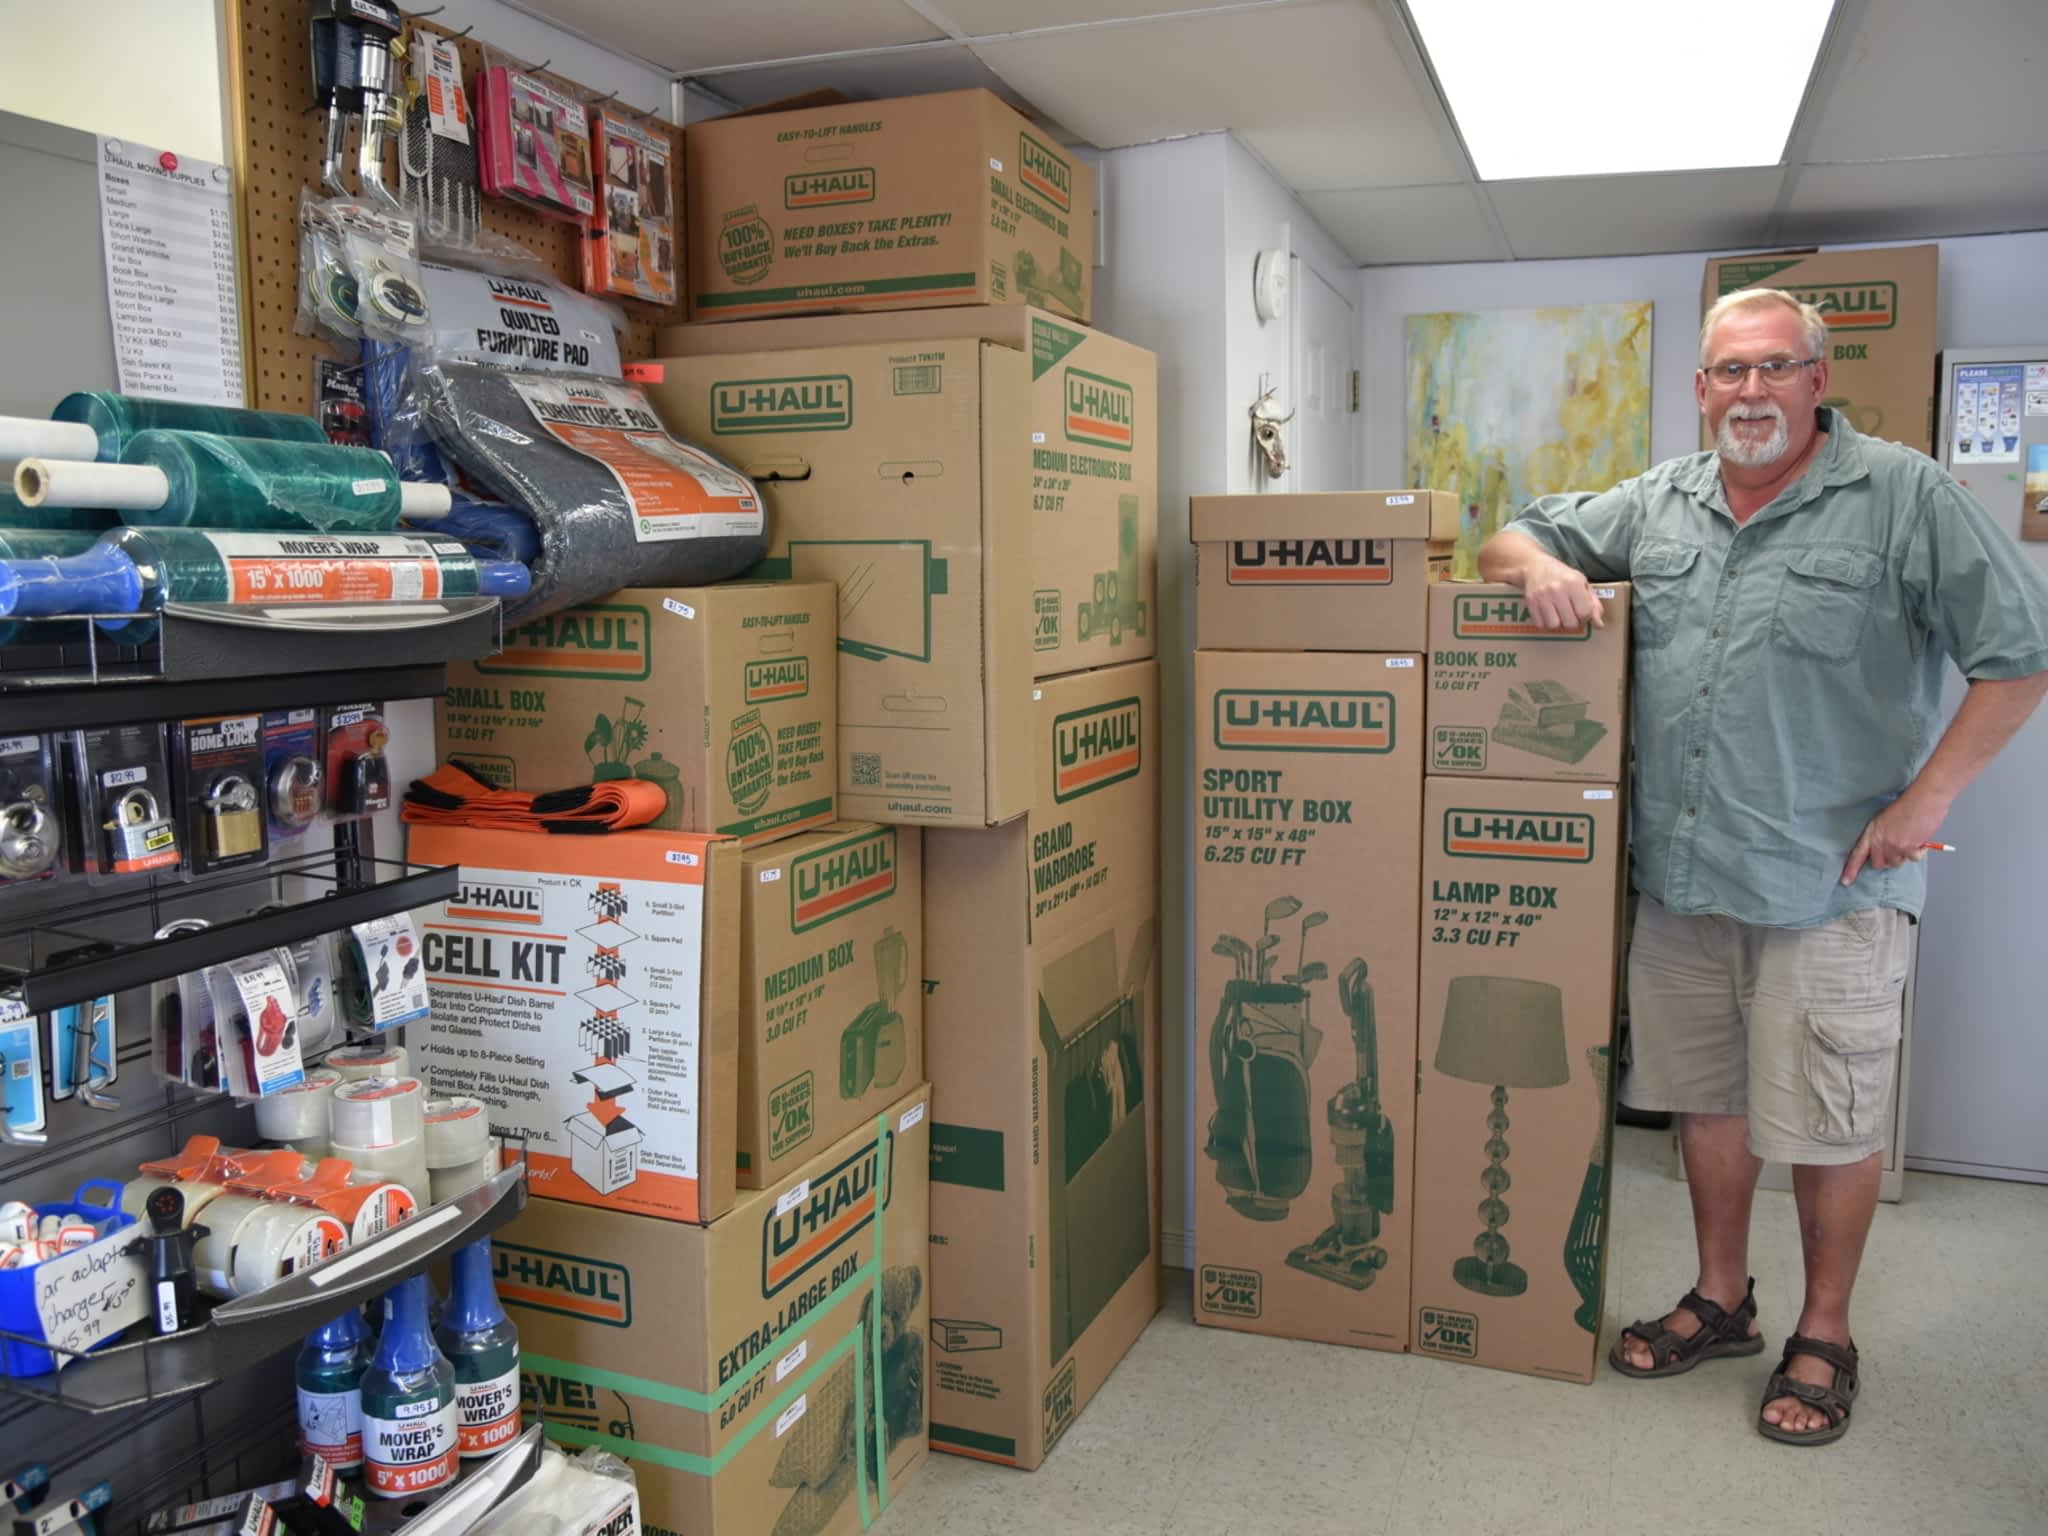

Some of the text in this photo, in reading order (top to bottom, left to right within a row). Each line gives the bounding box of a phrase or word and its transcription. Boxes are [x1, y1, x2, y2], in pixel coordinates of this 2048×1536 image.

[1023, 142, 1068, 192] U-HAUL
[790, 174, 870, 195] U-HAUL
[783, 212, 953, 240] NEED BOXES? TAKE PLENTY!
[783, 233, 940, 258] We'll Buy Back the Extras.
[797, 284, 866, 298] uhaul.com
[500, 308, 561, 336] QUILTED
[477, 328, 560, 362] FURNITURE
[563, 341, 590, 368] PAD
[1832, 343, 1868, 360] BOX
[719, 384, 844, 414] U-HAUL
[1069, 380, 1131, 425] U-HAUL
[531, 398, 659, 430] FURNITURE PAD
[279, 540, 381, 555] MOVER'S WRAP
[1234, 539, 1387, 567] U-HAUL
[1433, 650, 1518, 669] BOOK BOX
[749, 663, 805, 689] U-HAUL
[1466, 680, 1481, 692] FT
[446, 686, 546, 712] SMALL BOX
[1226, 699, 1383, 729] U-HAUL
[190, 729, 258, 751] HOME LOCK
[1059, 712, 1137, 767] U-HAUL
[1453, 743, 1481, 760] OK
[1203, 767, 1283, 794] SPORT
[887, 800, 953, 815] uhaul.com
[1203, 796, 1353, 824] UTILITY BOX
[1034, 821, 1073, 862] GRAND
[1205, 825, 1230, 840] 15"
[1231, 829, 1243, 841] x
[1247, 827, 1272, 841] 15"
[1274, 830, 1284, 842] x
[1454, 816, 1586, 844] U-HAUL
[1034, 840, 1097, 895] WARDROBE
[1204, 845, 1307, 867] 6.25 CU FT
[799, 839, 891, 901] U-HAUL
[449, 886, 539, 911] U-HAUL
[1431, 879, 1558, 910] LAMP BOX
[1433, 907, 1543, 928] 12" x 12" x 40"
[1432, 926, 1520, 948] 3.3 CU FT
[421, 931, 566, 985] CELL KIT
[765, 953, 824, 1003] MEDIUM
[827, 939, 855, 972] BOX
[430, 987, 472, 1002] Separates
[506, 995, 527, 1007] Dish
[528, 998, 555, 1010] Barrel
[430, 999, 447, 1010] Box
[533, 1011, 544, 1021] to
[430, 1011, 542, 1033] Isolate and Protect Dishes
[430, 1024, 447, 1034] and
[796, 1009, 809, 1029] FT
[430, 1043, 546, 1070] Holds up to 8-Piece Setting
[429, 1065, 551, 1090] Completely Fills U-Haul Dish
[430, 1076, 456, 1090] Barrel
[478, 1084, 500, 1095] Adds
[785, 1100, 811, 1133] OK
[830, 1250, 859, 1292] BOX
[1222, 1286, 1256, 1306] OK
[1440, 1329, 1473, 1348] OK
[457, 1384, 513, 1410] MOVER'S
[720, 1393, 737, 1430] 6.0
[738, 1387, 751, 1414] CU
[752, 1376, 765, 1401] FT
[464, 1402, 506, 1422] WRAP
[380, 1423, 444, 1448] MOVER'S
[390, 1442, 436, 1462] WRAP
